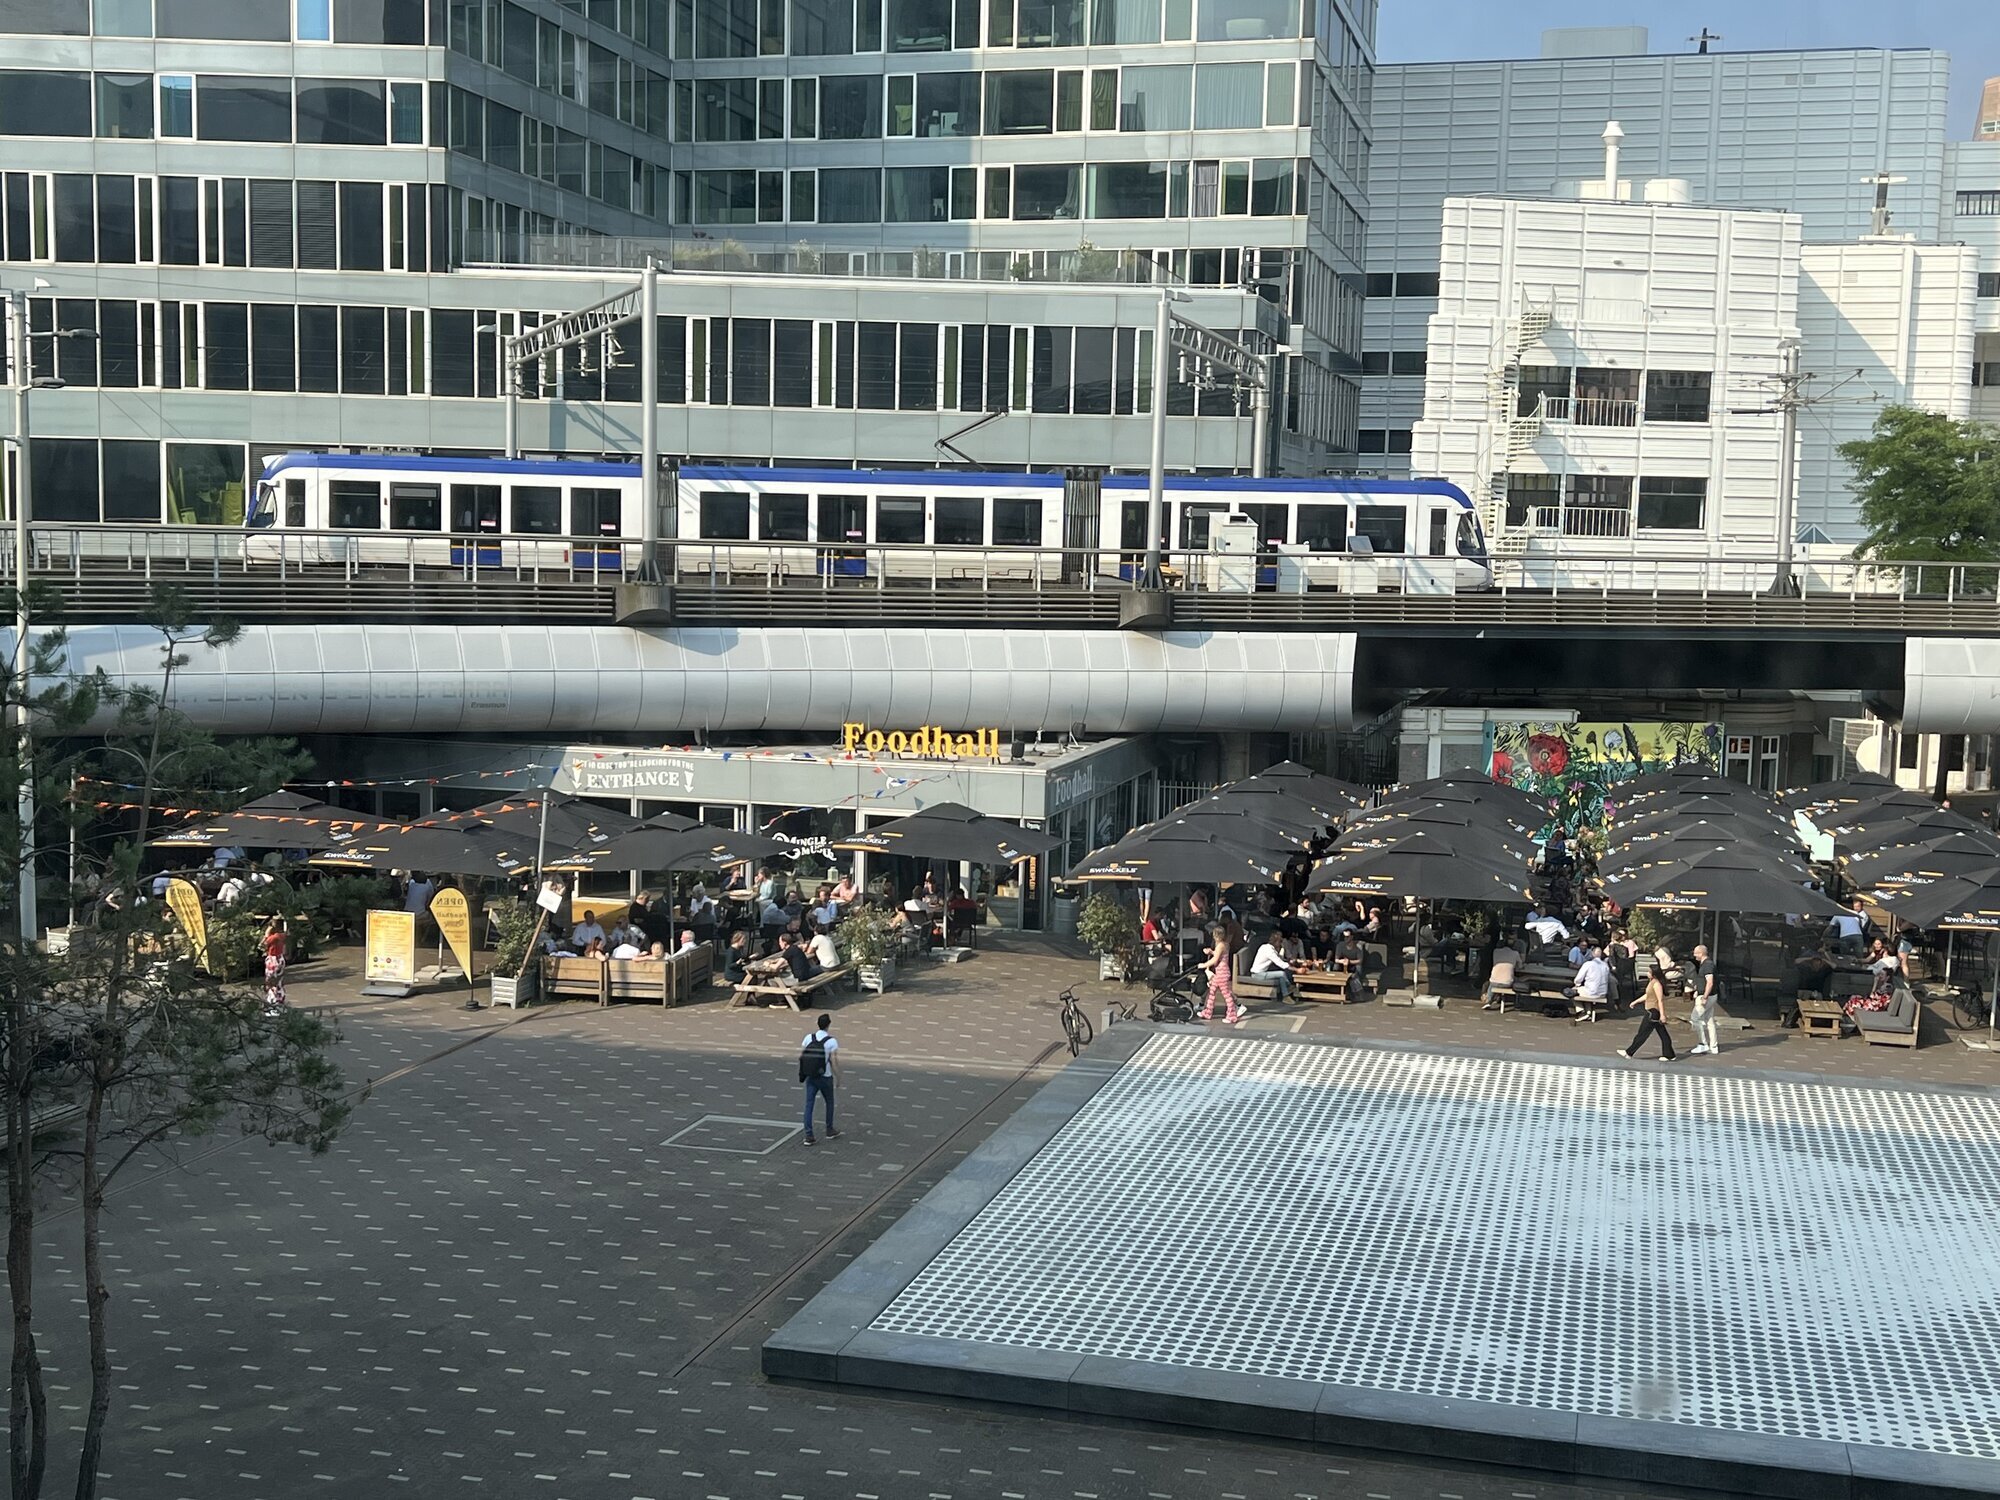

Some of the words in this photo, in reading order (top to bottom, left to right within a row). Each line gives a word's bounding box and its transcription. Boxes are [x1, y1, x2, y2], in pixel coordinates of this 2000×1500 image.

[470, 701, 507, 709] Erasmus
[843, 722, 999, 757] Foodhall
[638, 758, 668, 767] LOOKING
[668, 759, 681, 767] FOR
[681, 760, 694, 771] THE
[587, 771, 680, 789] ENTRANCE
[1055, 764, 1093, 806] Foodhall
